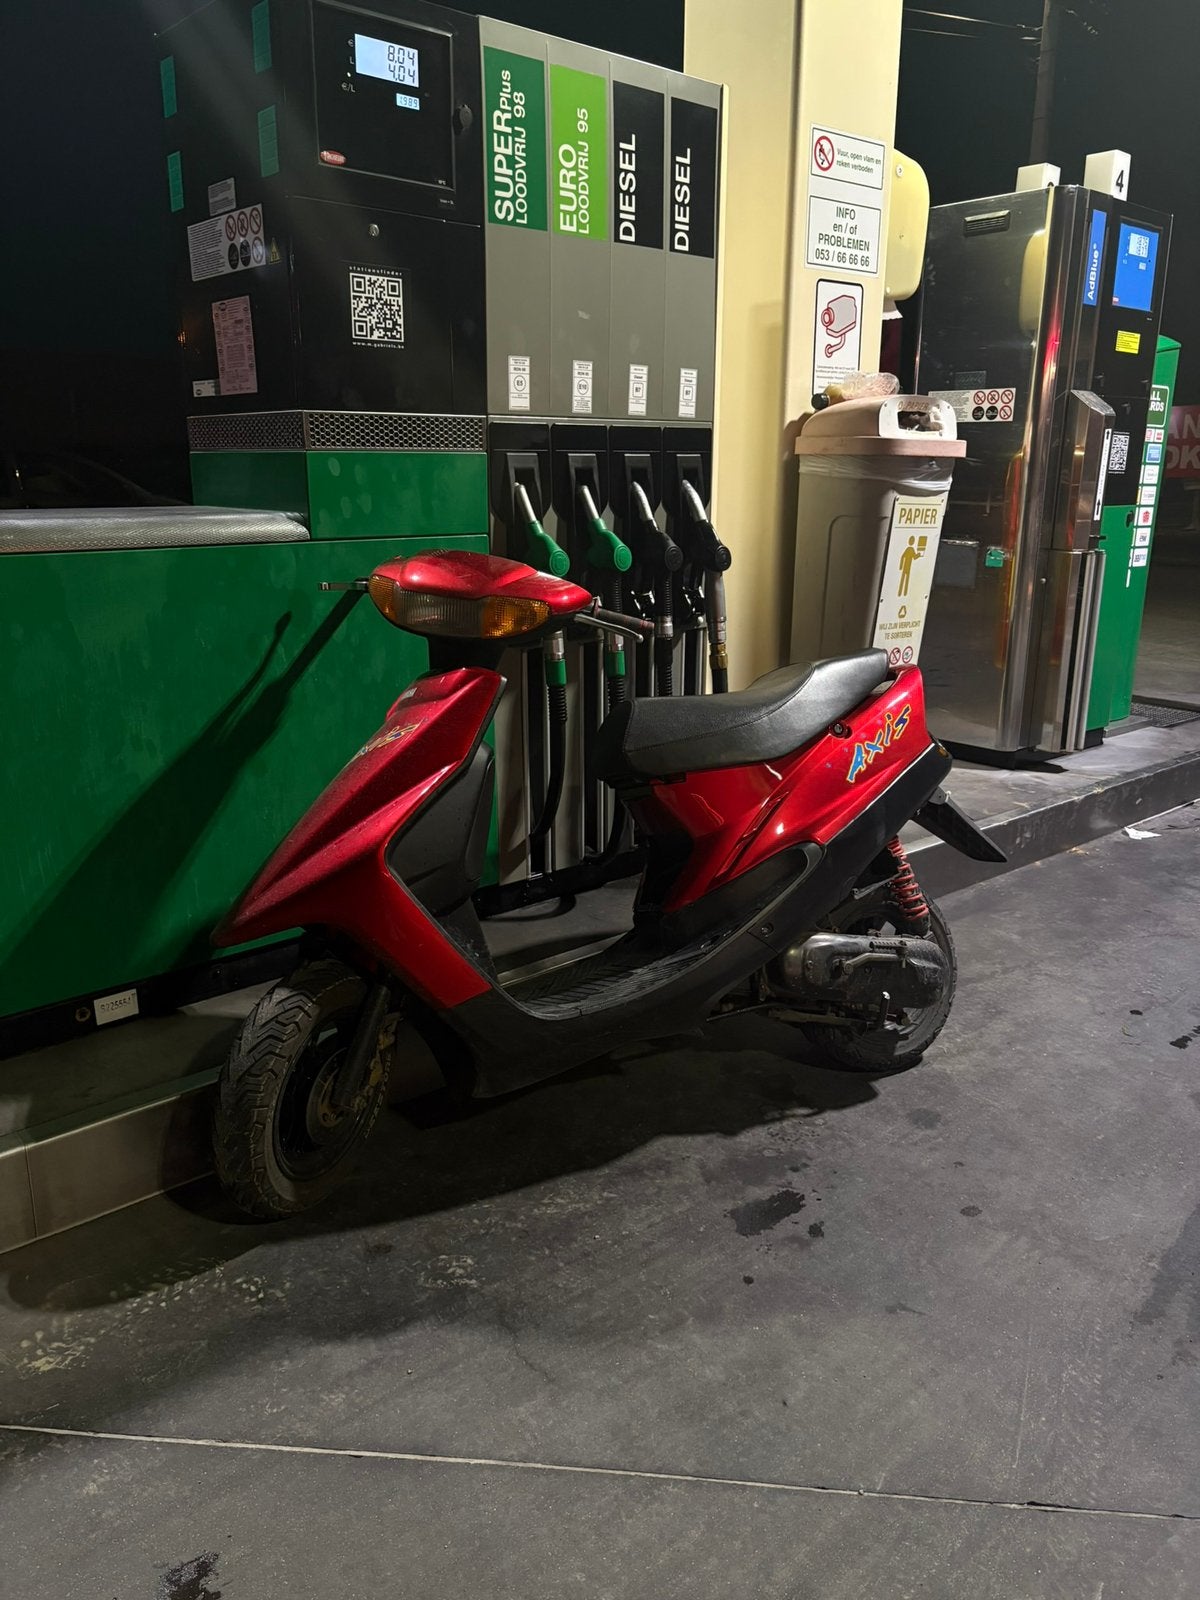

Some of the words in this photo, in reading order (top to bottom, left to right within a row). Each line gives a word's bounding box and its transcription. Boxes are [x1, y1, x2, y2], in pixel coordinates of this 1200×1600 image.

[513, 91, 526, 118] 98
[577, 107, 589, 133] 95
[836, 160, 850, 169] roken
[851, 163, 873, 174] verboden
[850, 152, 862, 162] open
[863, 154, 875, 164] vlam
[514, 126, 528, 225] LOODVRIJ
[577, 140, 590, 235] LOODVRIJ
[618, 133, 637, 242] DIESEL
[1115, 169, 1124, 193] 4
[558, 143, 578, 233] EURO
[674, 147, 691, 252] DIESEL
[836, 206, 856, 221] INFO
[832, 223, 843, 233] en
[849, 224, 858, 235] of
[818, 233, 870, 252] PROBLEMEN
[815, 248, 830, 261] 053
[837, 251, 847, 264] 66
[848, 253, 858, 266] 66
[860, 255, 870, 267] 66
[898, 507, 938, 525] PAPIER
